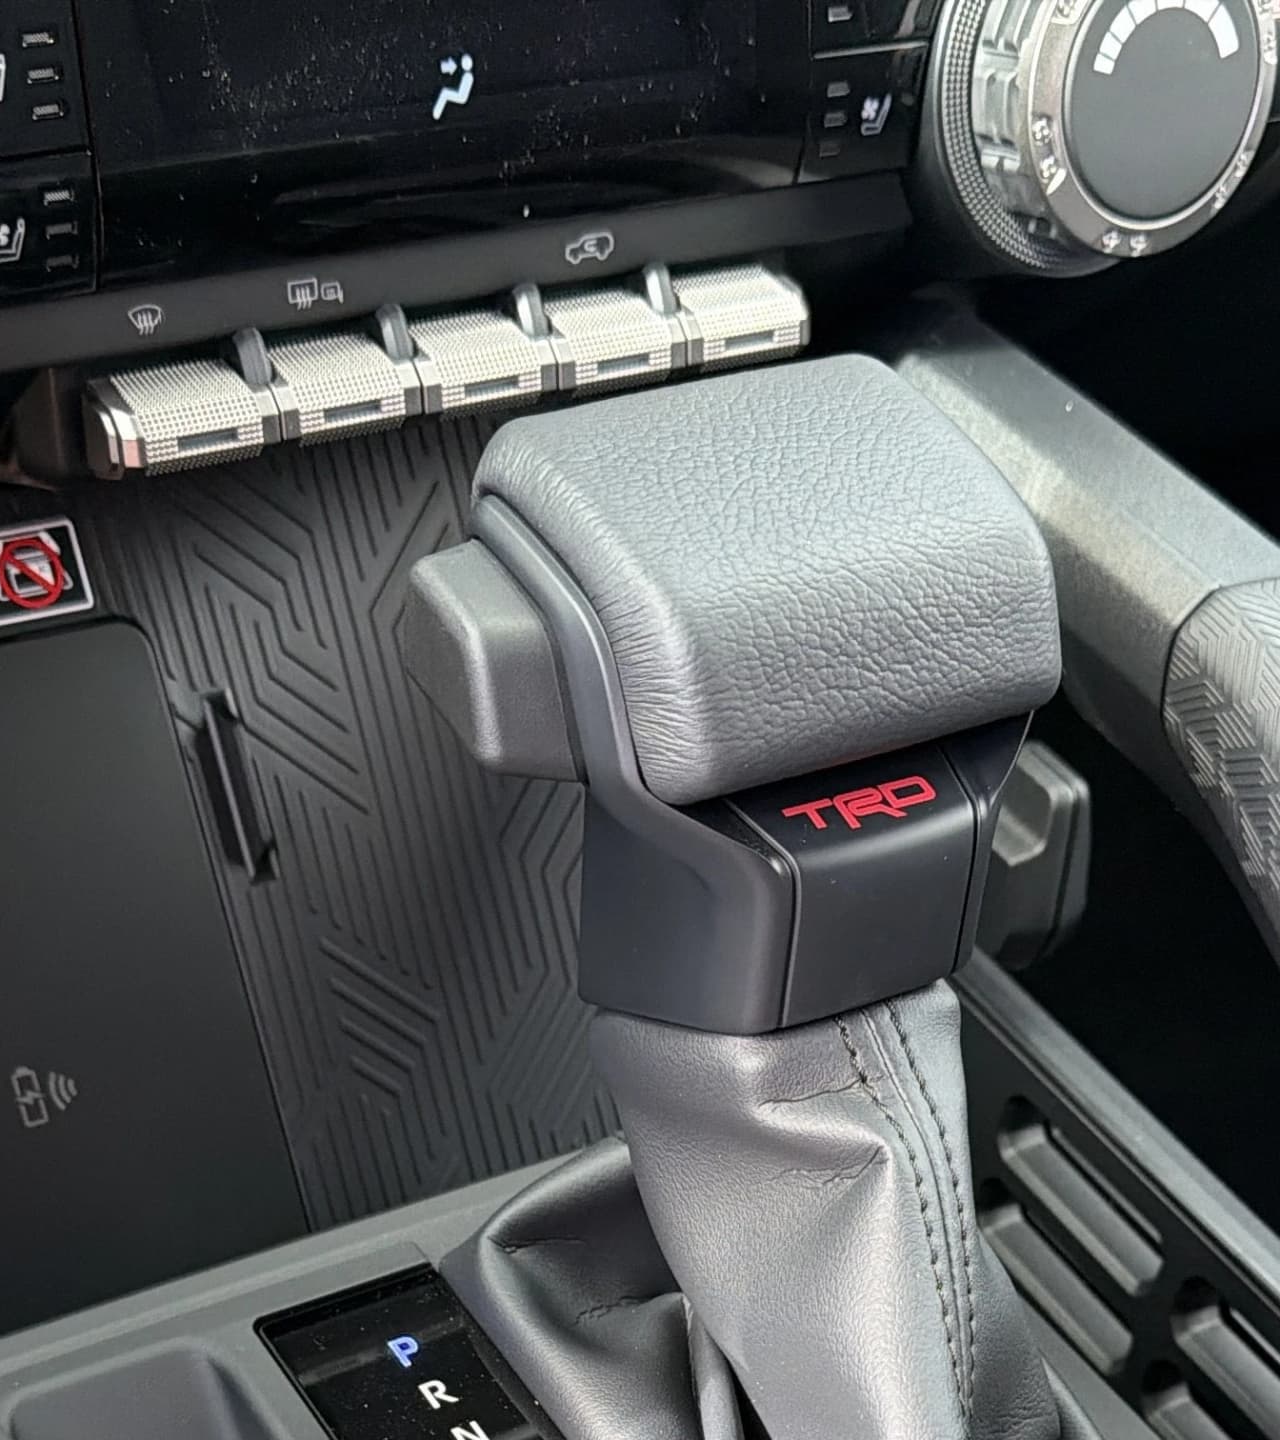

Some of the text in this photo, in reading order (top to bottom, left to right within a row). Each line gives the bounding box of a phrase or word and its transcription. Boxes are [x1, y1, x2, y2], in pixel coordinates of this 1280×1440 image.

[781, 775, 937, 829] TRD
[386, 1335, 420, 1368] P
[418, 1379, 460, 1410] R
